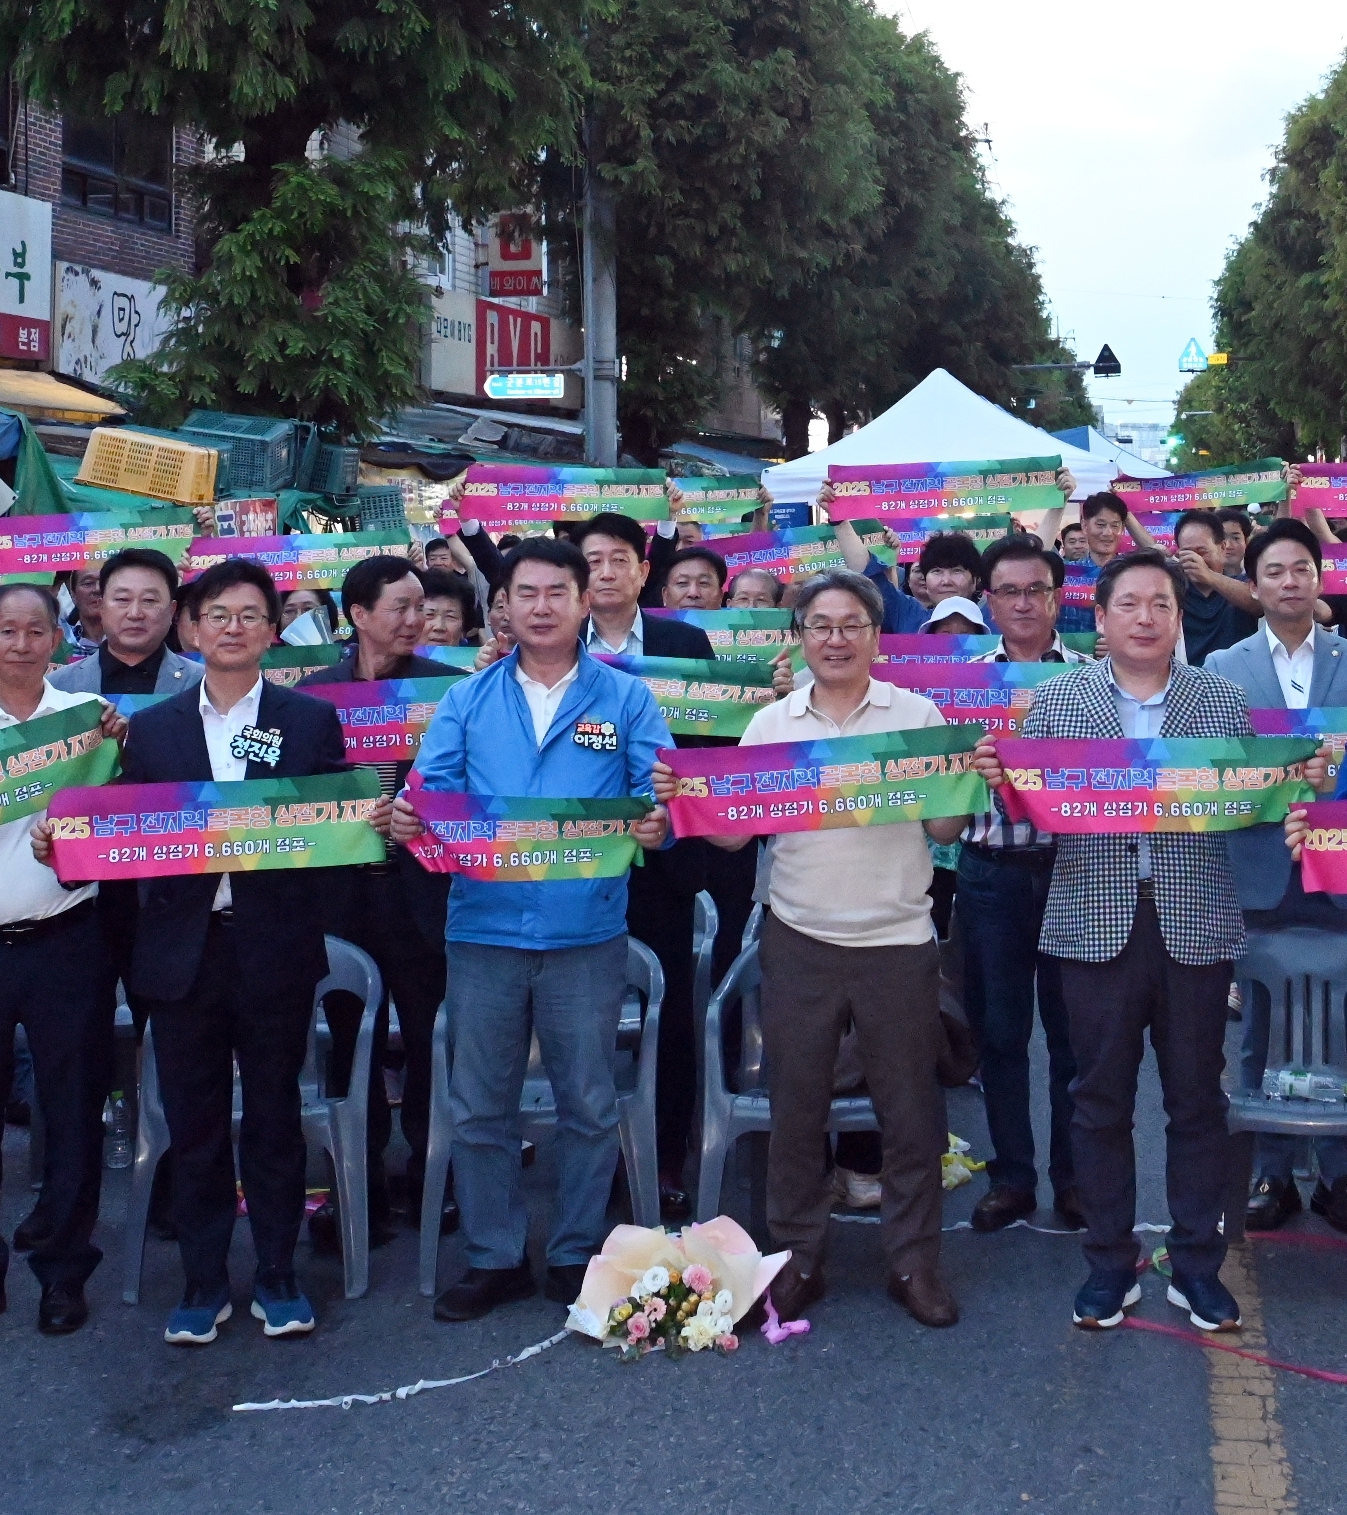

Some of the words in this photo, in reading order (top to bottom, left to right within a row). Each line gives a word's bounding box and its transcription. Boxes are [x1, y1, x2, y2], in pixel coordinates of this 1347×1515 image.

[18, 326, 38, 352] 본점
[465, 483, 498, 496] 2025
[499, 483, 523, 496] 남구
[525, 483, 562, 496] 전지역
[563, 484, 599, 496] 골목형
[602, 485, 638, 496] 상점가
[640, 486, 663, 497] 지정
[833, 482, 871, 496] 2025
[871, 480, 899, 494] 남구
[901, 478, 942, 492] 전지역
[943, 476, 984, 491] 골목형
[986, 473, 1026, 487] 상점가
[1028, 471, 1056, 485] 지정
[500, 503, 529, 511] -82개
[531, 502, 558, 511] 상점가
[560, 503, 599, 512] 6,660개
[601, 503, 625, 511] 점포-
[875, 500, 906, 511] -82개
[909, 498, 939, 509] 상점가
[941, 496, 984, 507] 6,660개
[987, 495, 1013, 505] 점포-
[14, 534, 41, 548] 남구
[43, 531, 84, 546] 전지역
[85, 528, 125, 544] 골목형
[128, 525, 167, 541] 상점가
[167, 524, 194, 538] 지정
[17, 553, 48, 564] -82개
[52, 552, 81, 562] 상점가
[299, 549, 338, 563] 골목형
[340, 546, 380, 561] 상점가
[296, 569, 337, 580] 6,660개
[735, 629, 781, 646] 상점가
[688, 682, 742, 702] 상점가
[954, 687, 1009, 708] 전지역
[684, 708, 718, 721] 점포-
[243, 725, 283, 748] 국회의원
[577, 723, 602, 734] 교육감
[362, 732, 401, 749] 상점가
[574, 734, 617, 750] 이정선
[5, 739, 67, 778] 상점가
[230, 736, 281, 767] 정진욱
[711, 774, 753, 797] 남구
[755, 768, 819, 794] 전지역
[819, 762, 882, 788] 골목형
[884, 755, 947, 780] 상점가
[1045, 768, 1088, 791] 남구
[1091, 768, 1155, 790] 전지역
[1155, 768, 1219, 791] 골목형
[1221, 767, 1284, 790] 상점가
[13, 780, 53, 802] 점포-
[717, 803, 764, 822] -82개
[769, 800, 814, 818] 상점가
[818, 795, 883, 814] 6,660개
[887, 790, 927, 806] 점포-
[1050, 802, 1097, 817] -82개
[1103, 801, 1149, 817] 상점가
[1153, 802, 1219, 817] 6,660개
[1224, 801, 1262, 817] 점포-
[94, 814, 138, 837] 남구
[141, 808, 206, 835] 전지역
[206, 805, 271, 831] 골목형
[274, 801, 339, 827] 상점가
[430, 820, 494, 843] 전지역
[495, 819, 560, 842] 골목형
[562, 817, 626, 839] 상점가
[98, 844, 147, 864] -82개
[153, 842, 199, 861] 상점가
[205, 839, 271, 859] 6,660개
[275, 836, 317, 853] 점포-
[493, 851, 558, 869] 6,660개
[563, 848, 603, 864] 점포-
